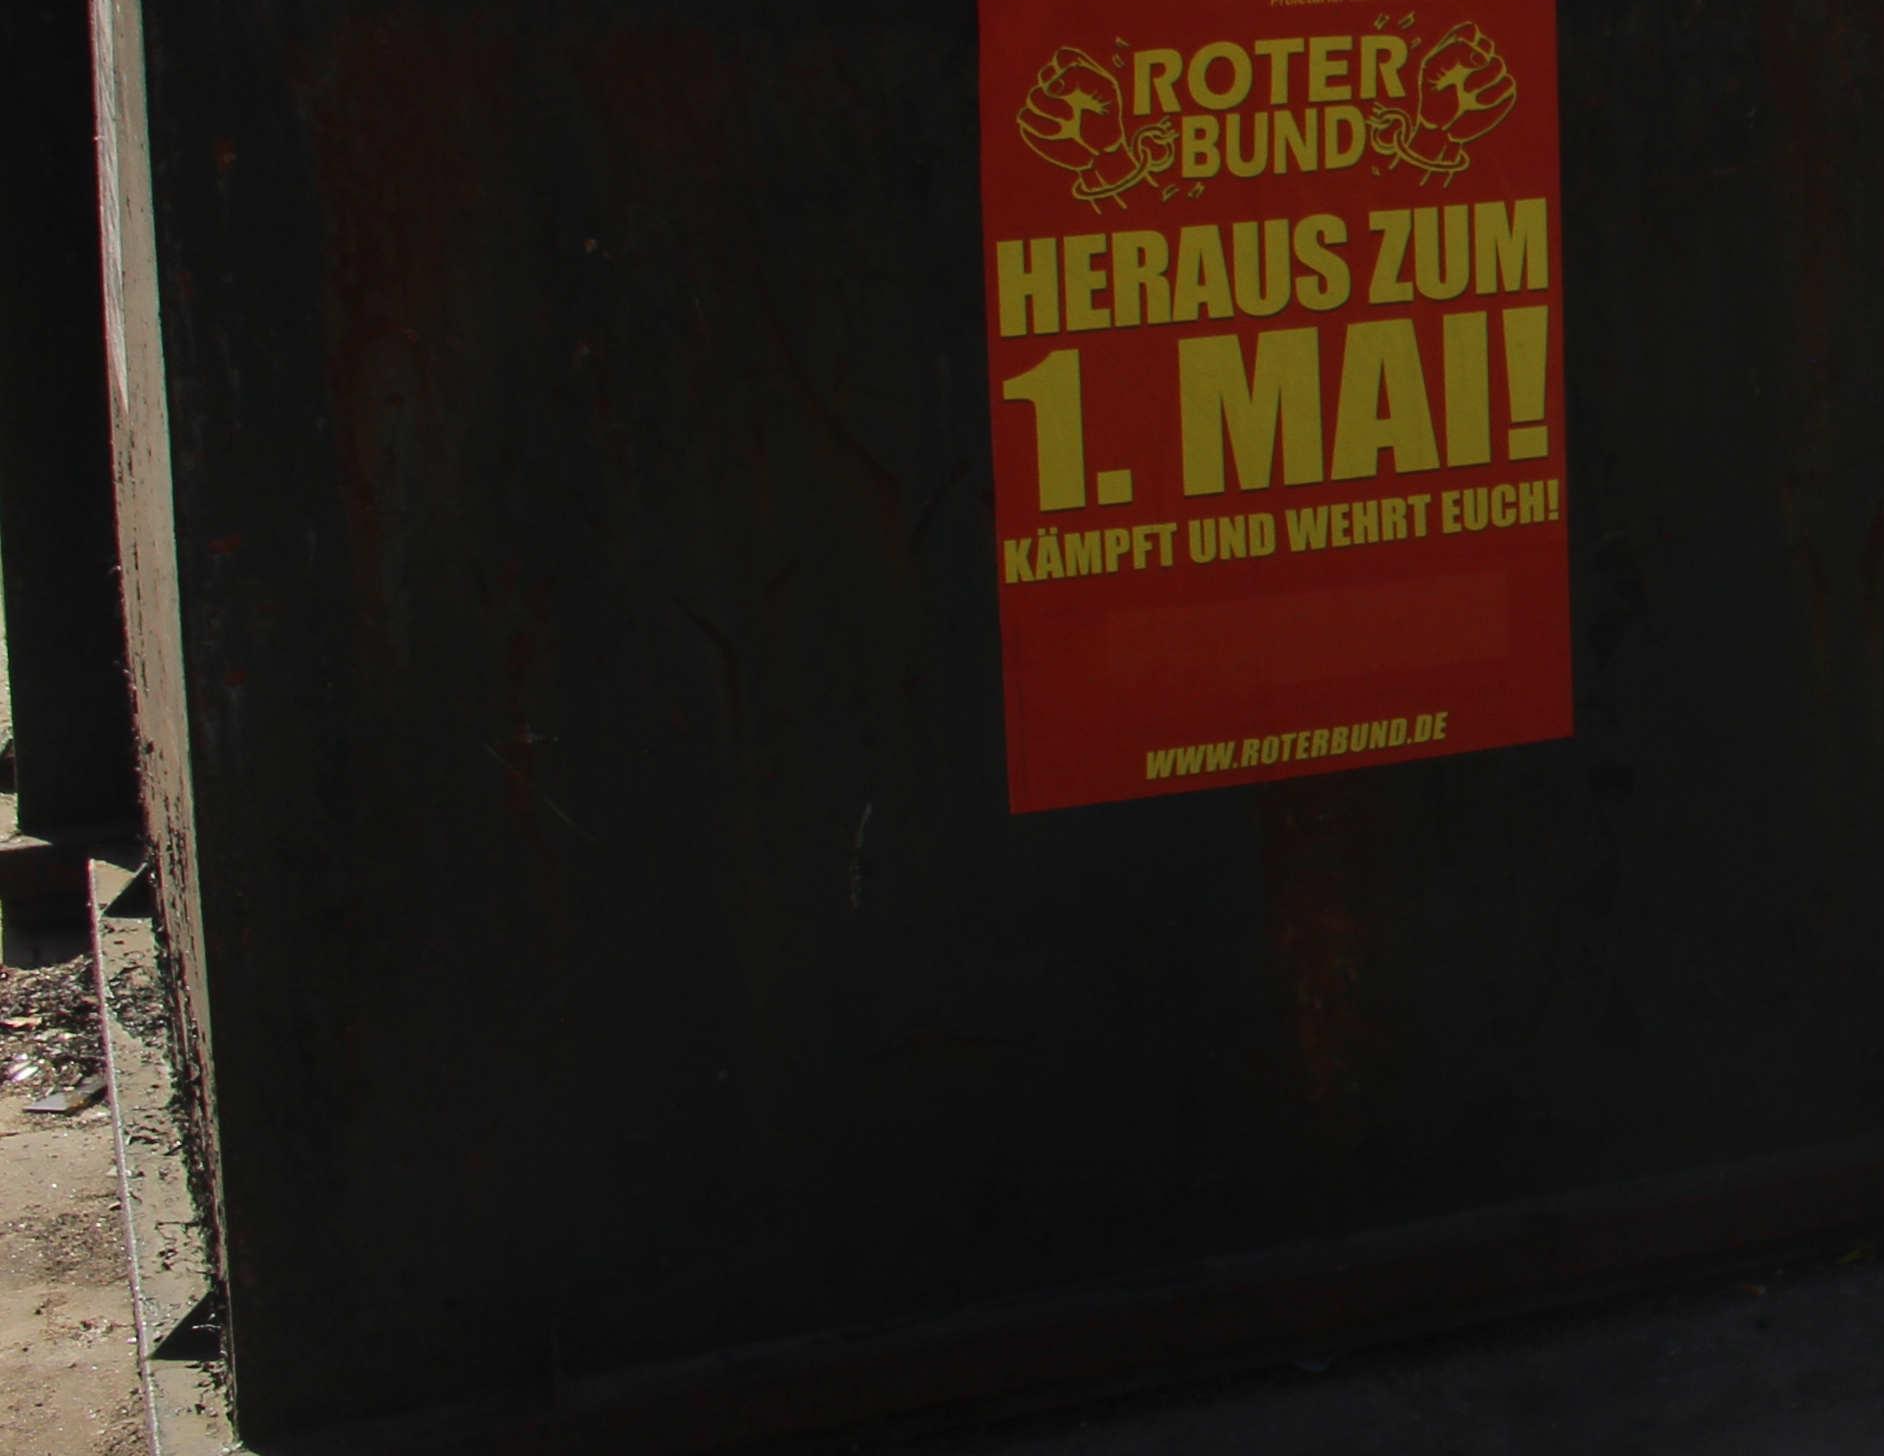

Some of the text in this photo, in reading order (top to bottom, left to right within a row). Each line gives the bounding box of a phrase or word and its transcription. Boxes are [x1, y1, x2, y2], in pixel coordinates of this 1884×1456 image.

[1134, 34, 1409, 116] ROTER
[1181, 105, 1368, 179] BUND
[996, 197, 1549, 337] HERAUS ZUM
[1003, 304, 1550, 512] 1. MAI!
[1003, 478, 1560, 584] KÄMPFT UND WEHRT EUCH!
[1145, 711, 1449, 781] WWW.ROTERBUND.DE
